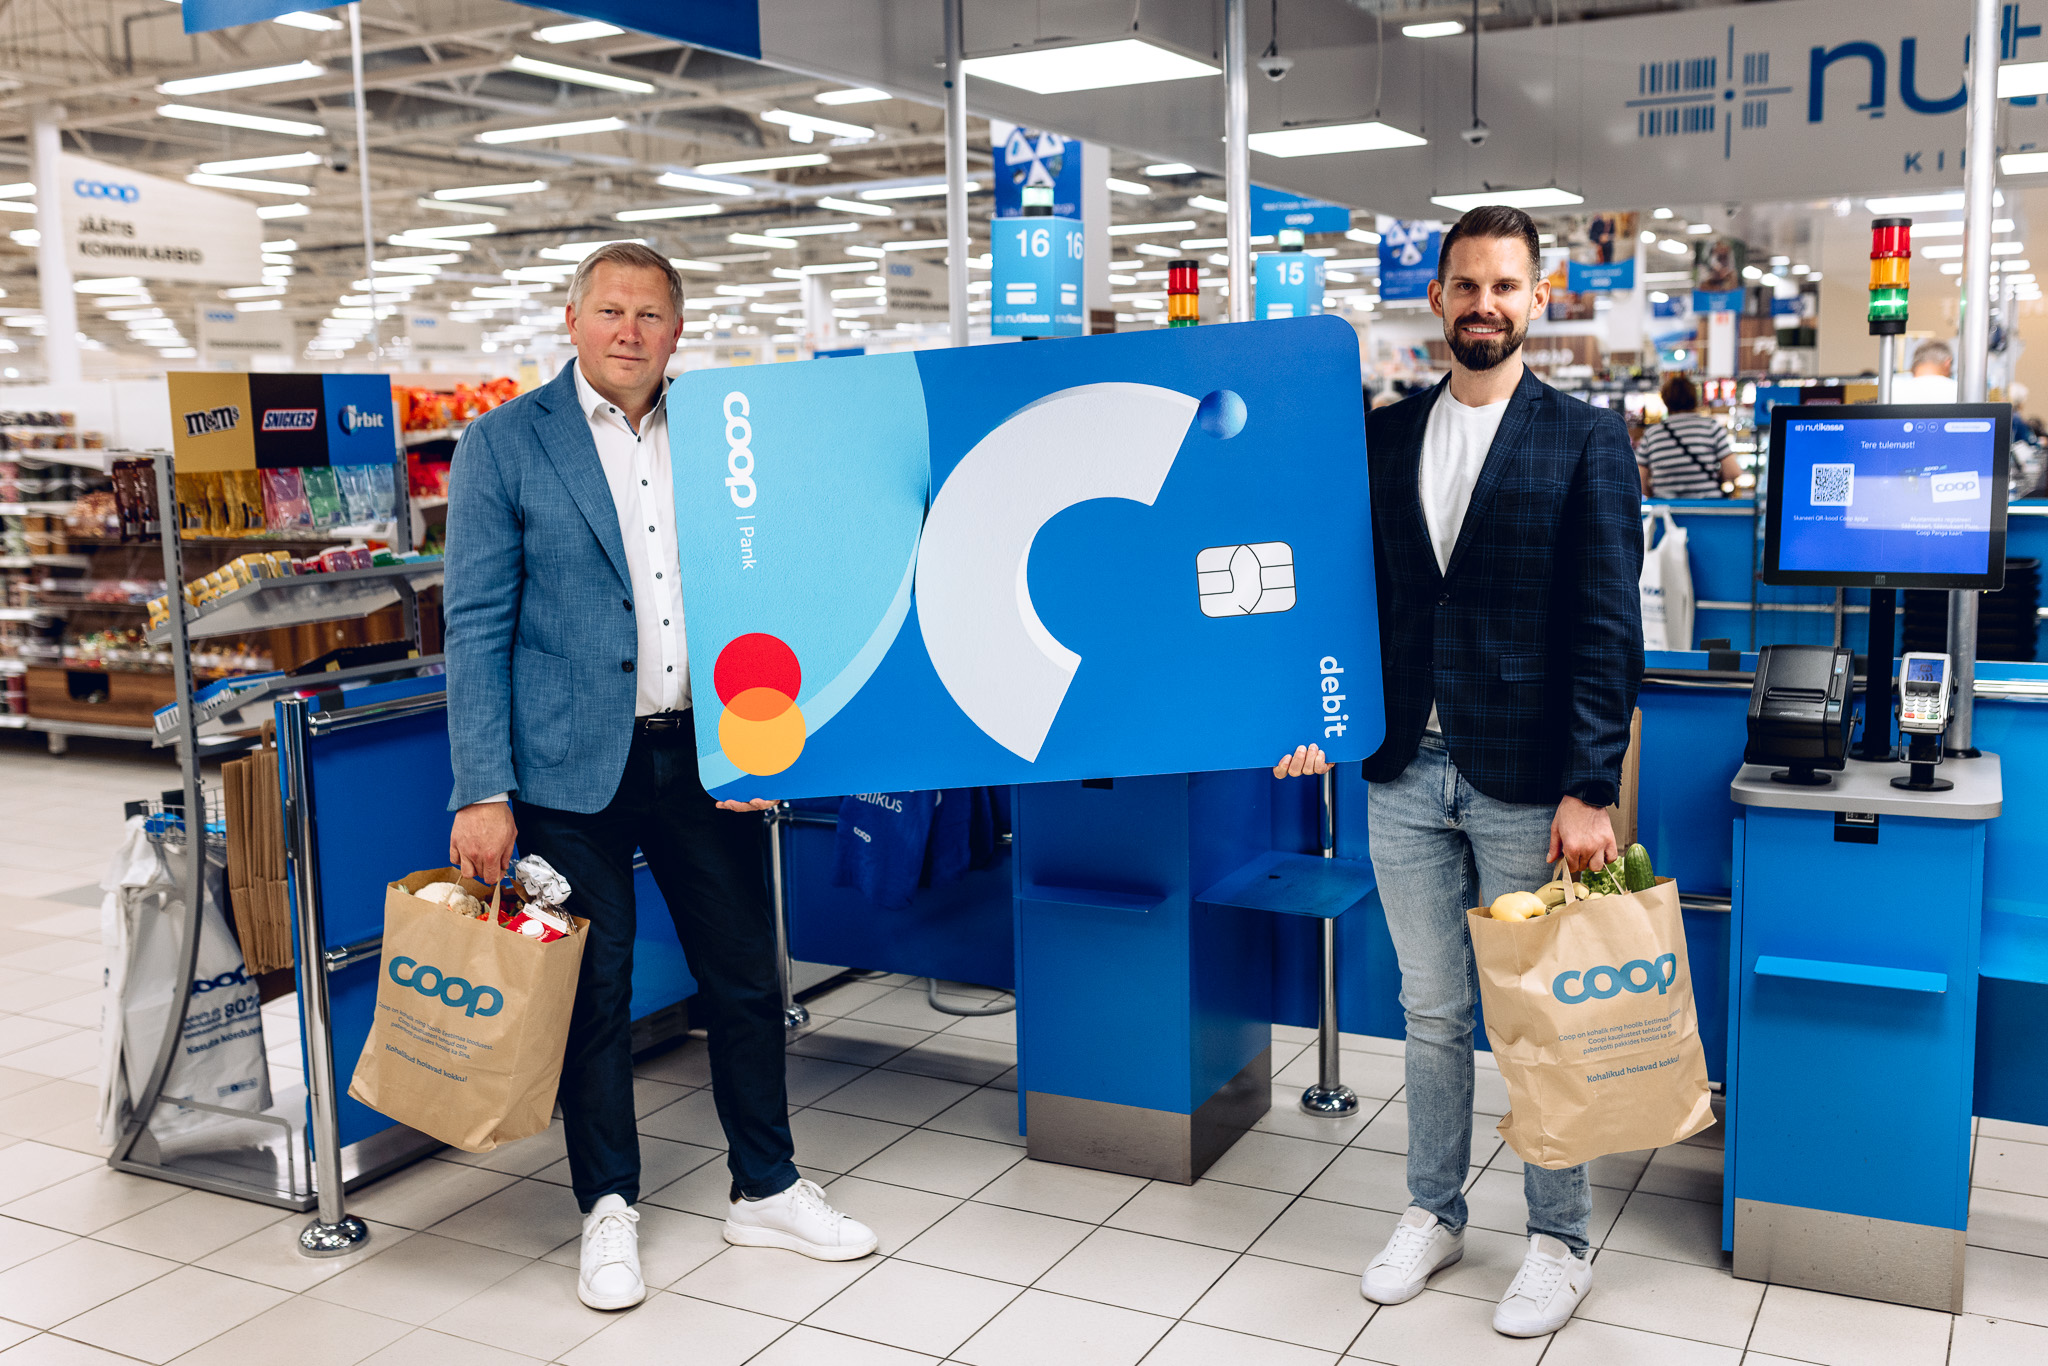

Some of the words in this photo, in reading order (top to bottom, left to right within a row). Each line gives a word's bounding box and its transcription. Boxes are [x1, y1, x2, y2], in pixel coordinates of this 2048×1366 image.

[1807, 3, 2048, 124] nut
[1016, 228, 1050, 258] 16
[1066, 231, 1084, 260] 16
[1276, 261, 1305, 286] 15
[264, 412, 315, 428] SNICKERS
[337, 404, 384, 436] Orbit
[1805, 423, 1844, 432] nutikassa
[723, 391, 757, 508] coop
[1861, 440, 1877, 450] Tere
[1879, 440, 1916, 450] tulemast!
[1935, 481, 1976, 493] coop
[739, 526, 757, 570] Pank
[1320, 656, 1349, 738] debit
[850, 792, 902, 813] alikus
[190, 963, 252, 995] oop
[388, 956, 504, 1018] coop
[1552, 952, 1676, 1004] coop
[225, 993, 261, 1018] 80%
[1559, 1034, 1576, 1042] Coop
[1587, 1028, 1608, 1038] kohalik
[1610, 1024, 1623, 1033] ning
[1624, 1021, 1643, 1030] hoolib
[1583, 1044, 1613, 1055] paberkotti
[1614, 1037, 1640, 1049] pakkides
[1640, 1034, 1659, 1043] hoolid
[1608, 1030, 1641, 1042] kauplustest
[1642, 1025, 1661, 1035] tehtud
[385, 1043, 415, 1063] Kohalikud
[416, 1059, 442, 1074] hoiavad
[443, 1070, 467, 1082] kokku!
[1587, 1068, 1625, 1083] Kohalikud
[1626, 1061, 1658, 1075] hoiavad
[1659, 1054, 1680, 1068] kokku!
